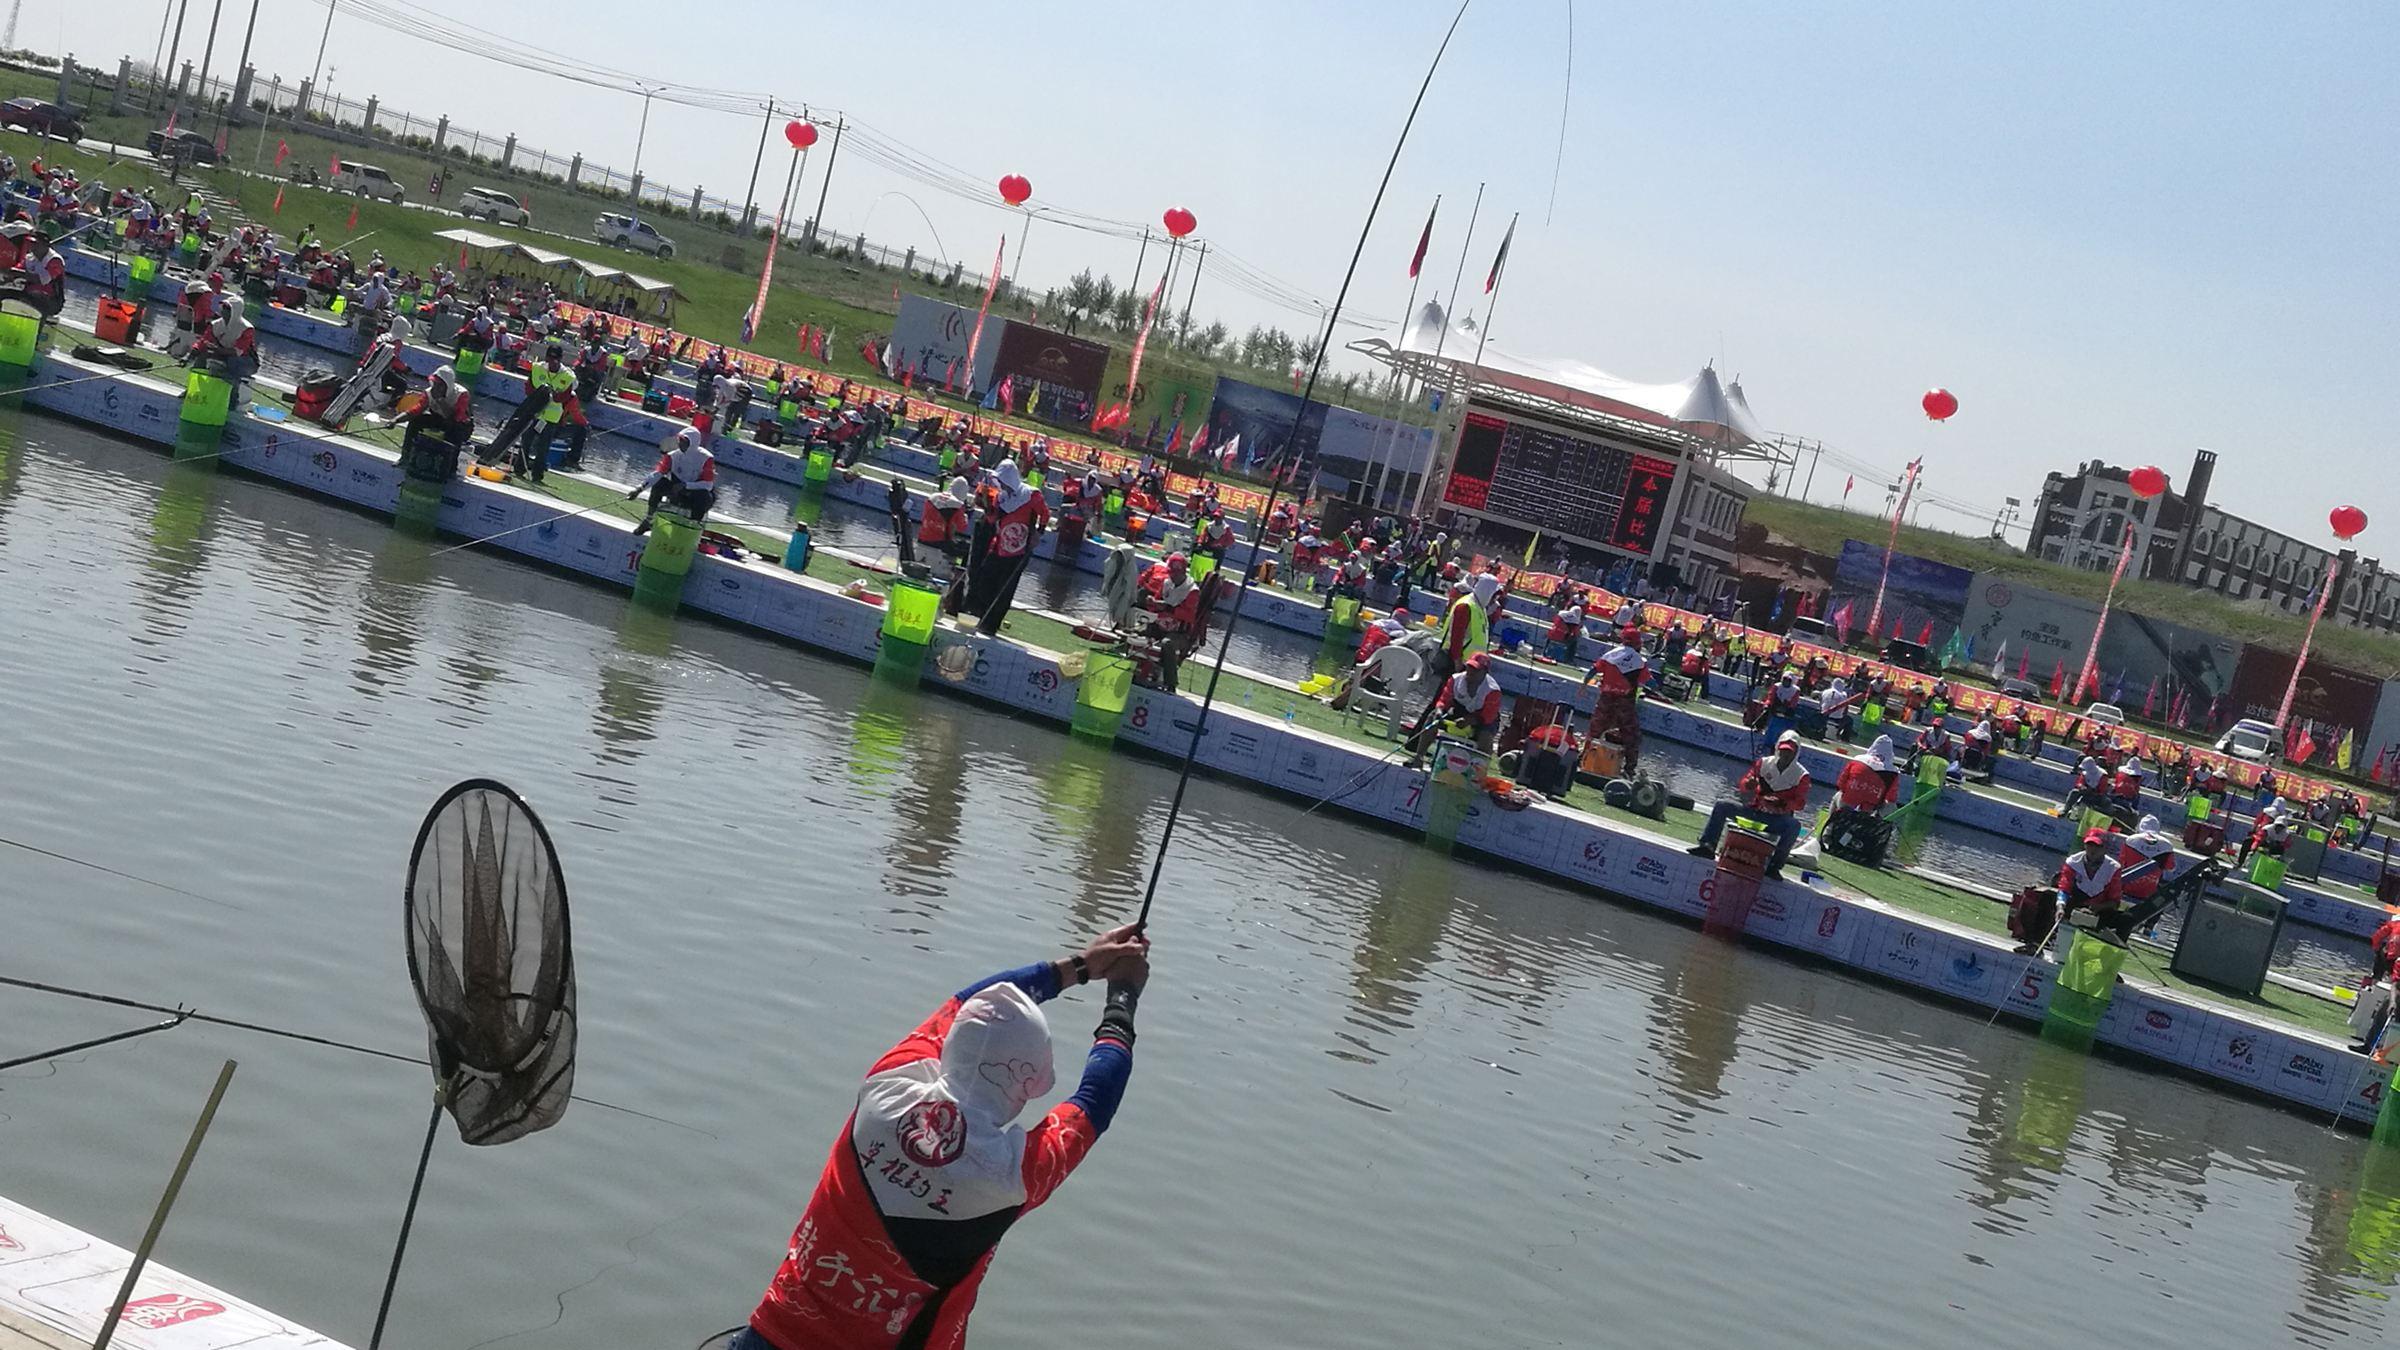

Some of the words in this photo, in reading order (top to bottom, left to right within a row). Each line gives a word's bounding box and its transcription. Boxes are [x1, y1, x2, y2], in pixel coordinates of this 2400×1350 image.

[1132, 706, 1148, 728] 8
[1404, 786, 1421, 808] 7
[1636, 862, 1665, 877] Garcia
[1647, 859, 1667, 871] Abu
[1699, 879, 1713, 901] 6
[2021, 975, 2041, 1000] 5
[2289, 1059, 2322, 1077] Garcia
[2304, 1057, 2324, 1069] Abu
[2360, 1081, 2382, 1105] 4
